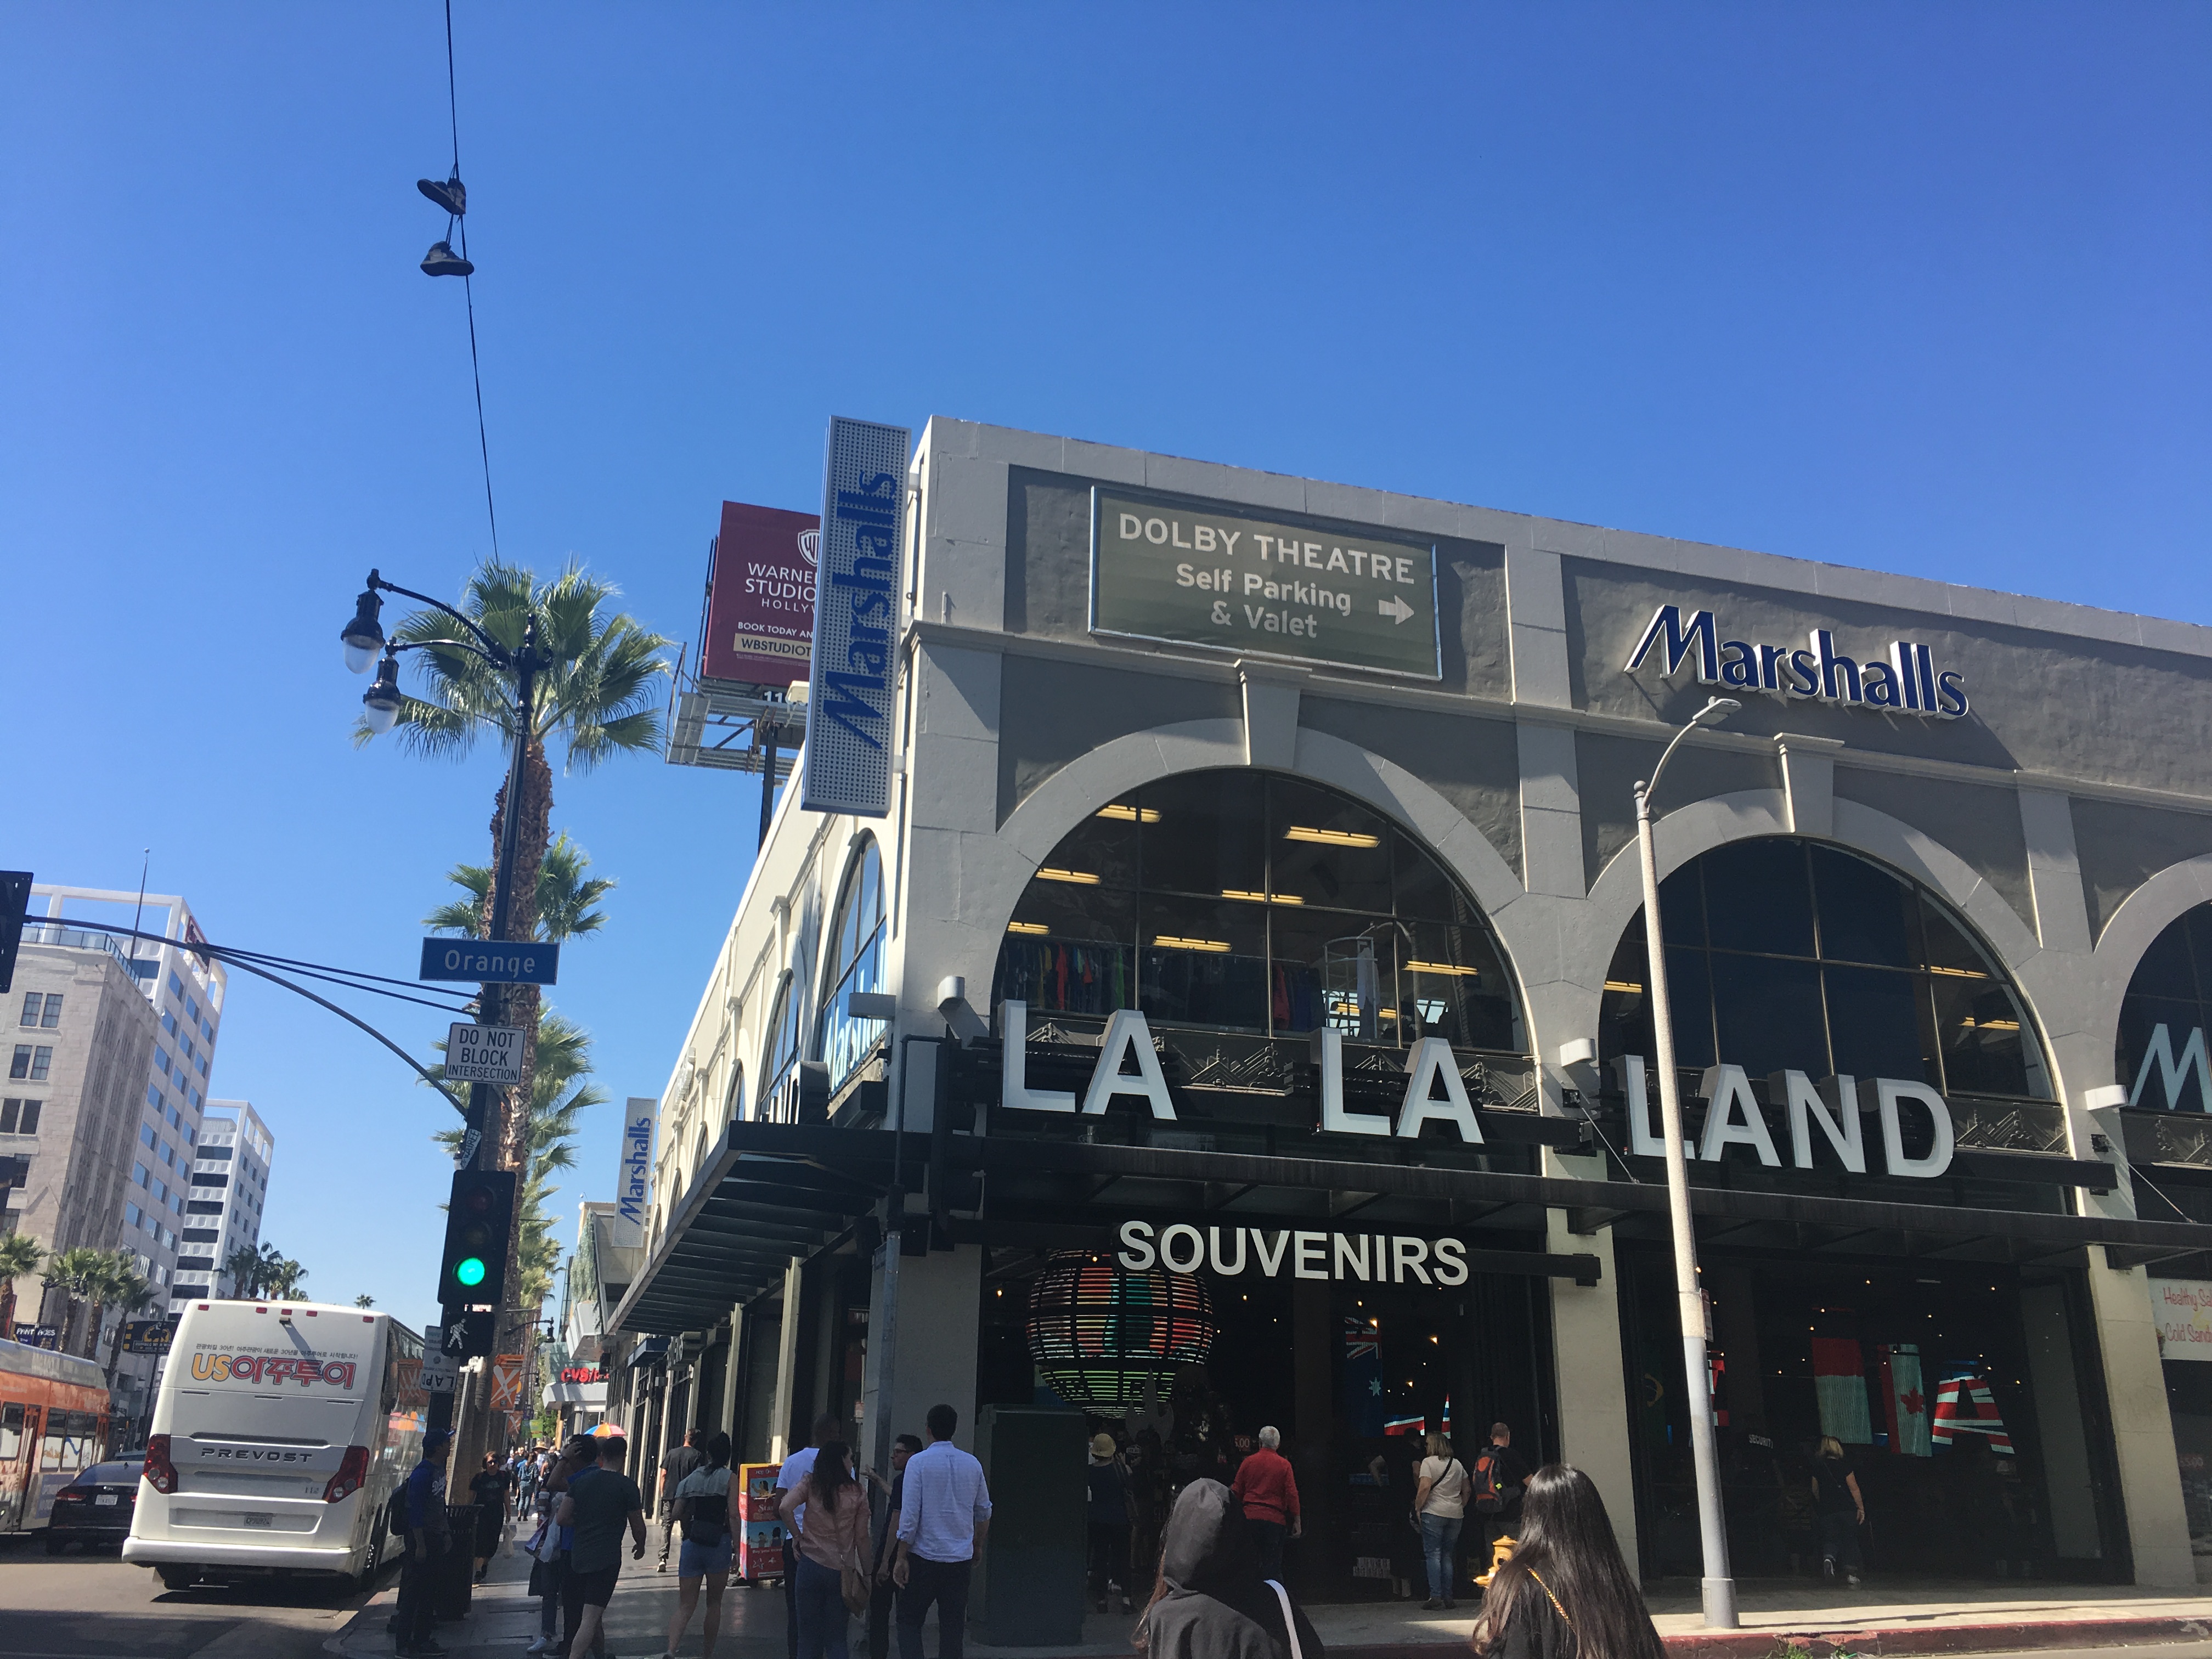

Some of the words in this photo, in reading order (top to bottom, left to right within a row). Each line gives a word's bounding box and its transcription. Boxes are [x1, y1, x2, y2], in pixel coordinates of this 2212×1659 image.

[1119, 513, 1242, 556] DOLBY
[1254, 534, 1415, 584] THEATRE
[1176, 562, 1232, 594] Self
[1244, 573, 1352, 617] Parking
[823, 470, 898, 751] Marshalls
[1211, 601, 1232, 627] &
[1243, 604, 1318, 639] Valet
[738, 621, 765, 633] BOOK
[768, 625, 797, 637] TODAY
[1624, 604, 1970, 721] Marshalls
[444, 949, 536, 978] Orange
[459, 1028, 480, 1045] DO
[486, 1032, 516, 1047] NOT
[448, 1065, 518, 1081] INTERSECTION
[460, 1047, 509, 1066] BLOCK
[997, 1000, 1178, 1121] LA
[1310, 1026, 1485, 1145] LA
[1612, 1054, 1955, 1178] LAND
[619, 1116, 651, 1226] Marshalls
[1117, 1221, 1469, 1286] SOUVENIRS
[2163, 1286, 2198, 1311] Healthy
[2165, 1322, 2186, 1342] Cold
[201, 1448, 313, 1463] PREVOST
